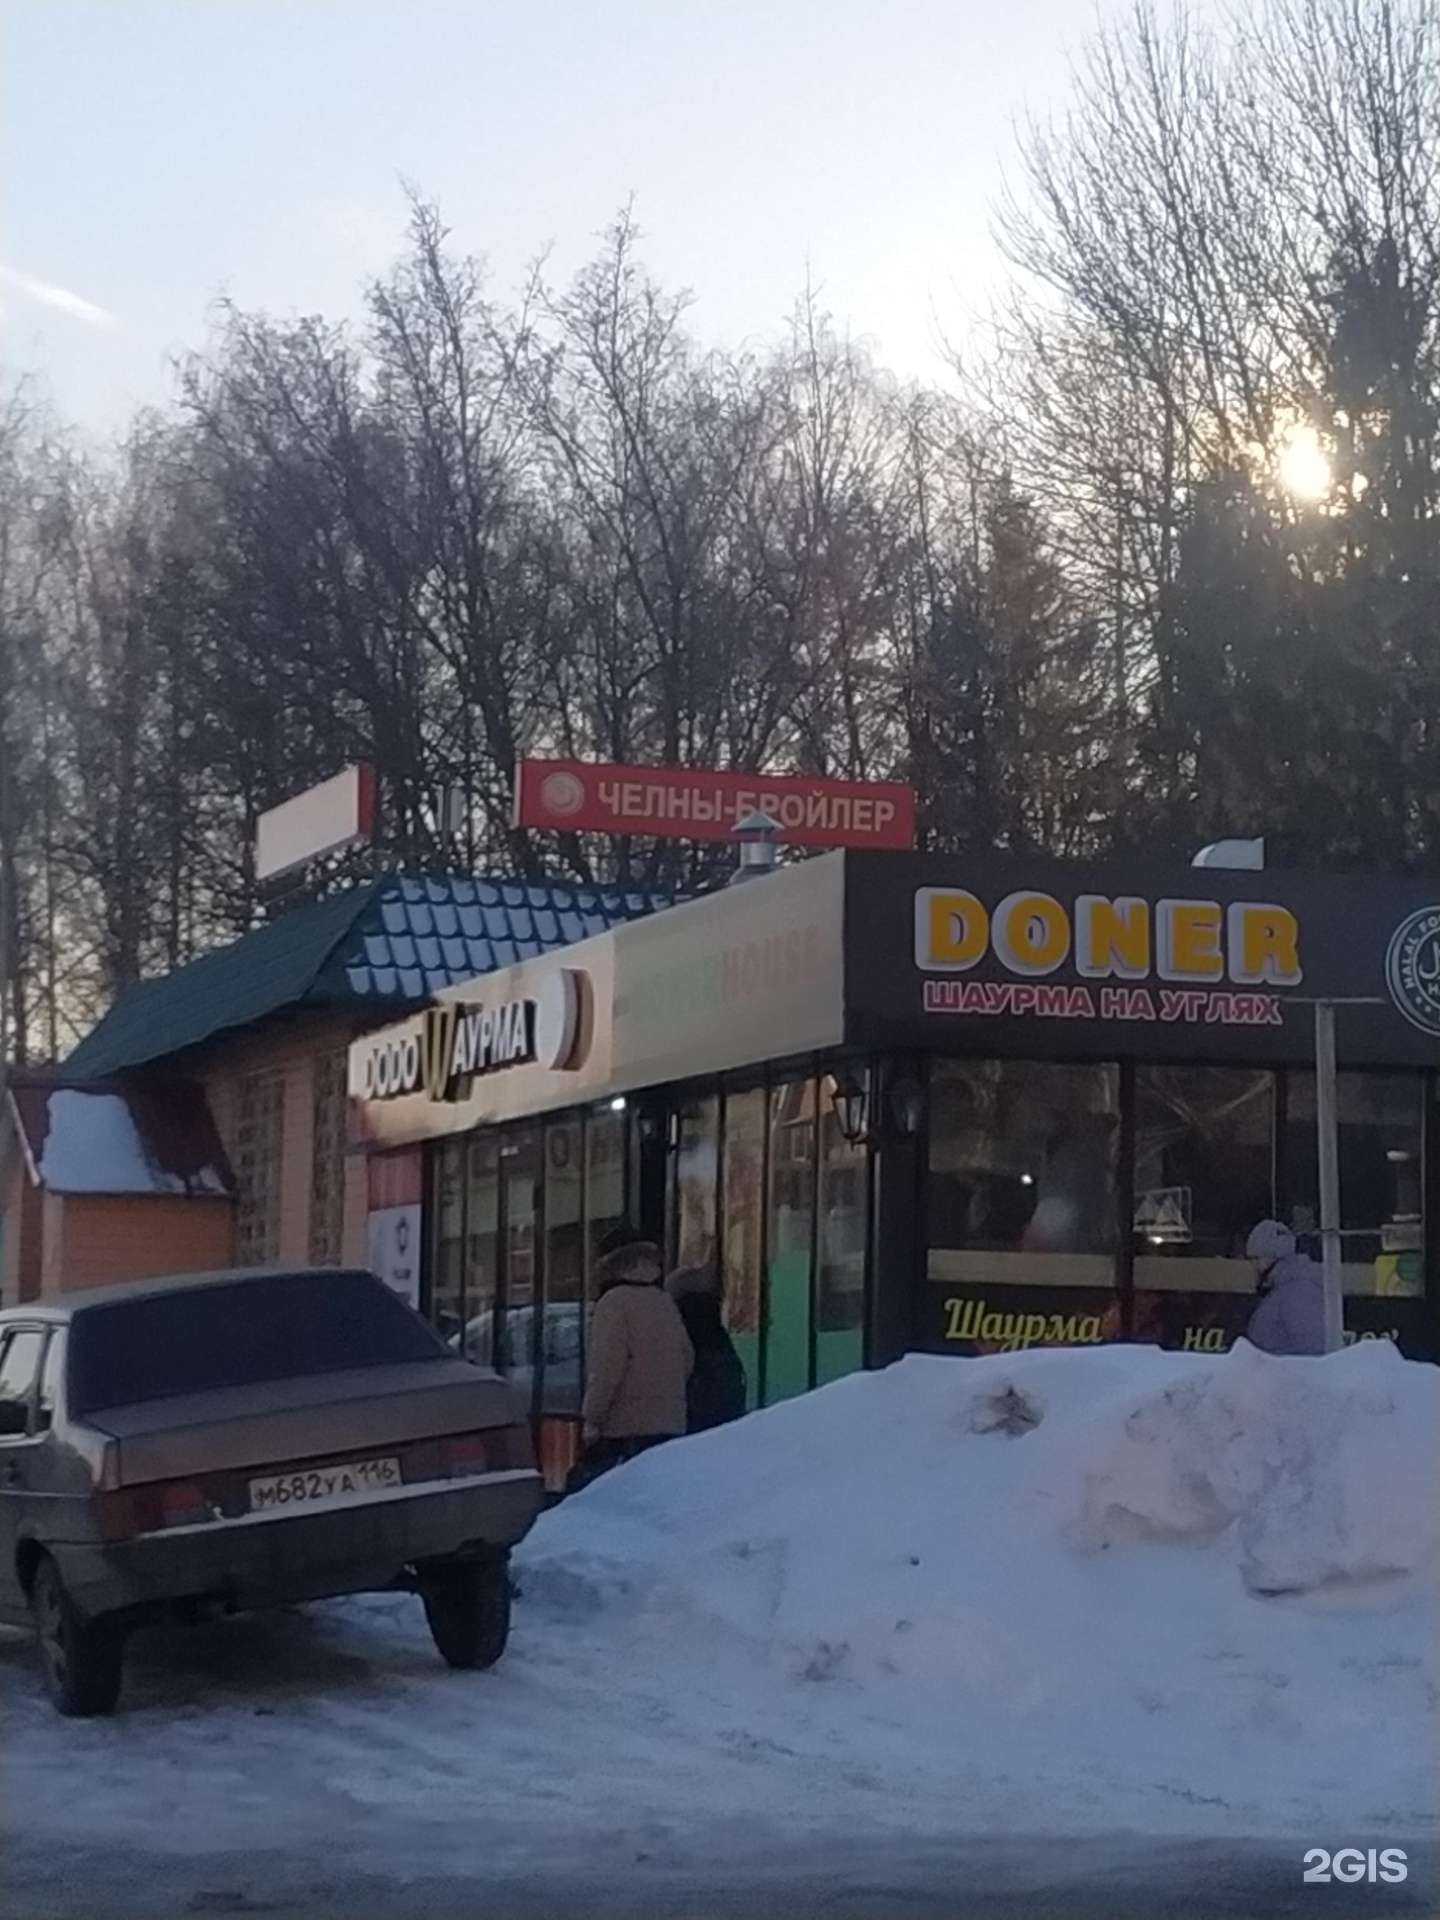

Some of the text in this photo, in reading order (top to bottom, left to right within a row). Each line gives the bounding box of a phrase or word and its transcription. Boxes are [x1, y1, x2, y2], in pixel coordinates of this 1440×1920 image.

[598, 781, 896, 832] ЧЕЛНЫ-БРОЙЛЕР
[914, 886, 1303, 986] DONER
[1401, 936, 1420, 990] HALAL
[1417, 914, 1440, 934] FO
[923, 979, 1284, 1026] ШАУРМА НА УГЛЯХ
[943, 1297, 1227, 1351] Шаурма на
